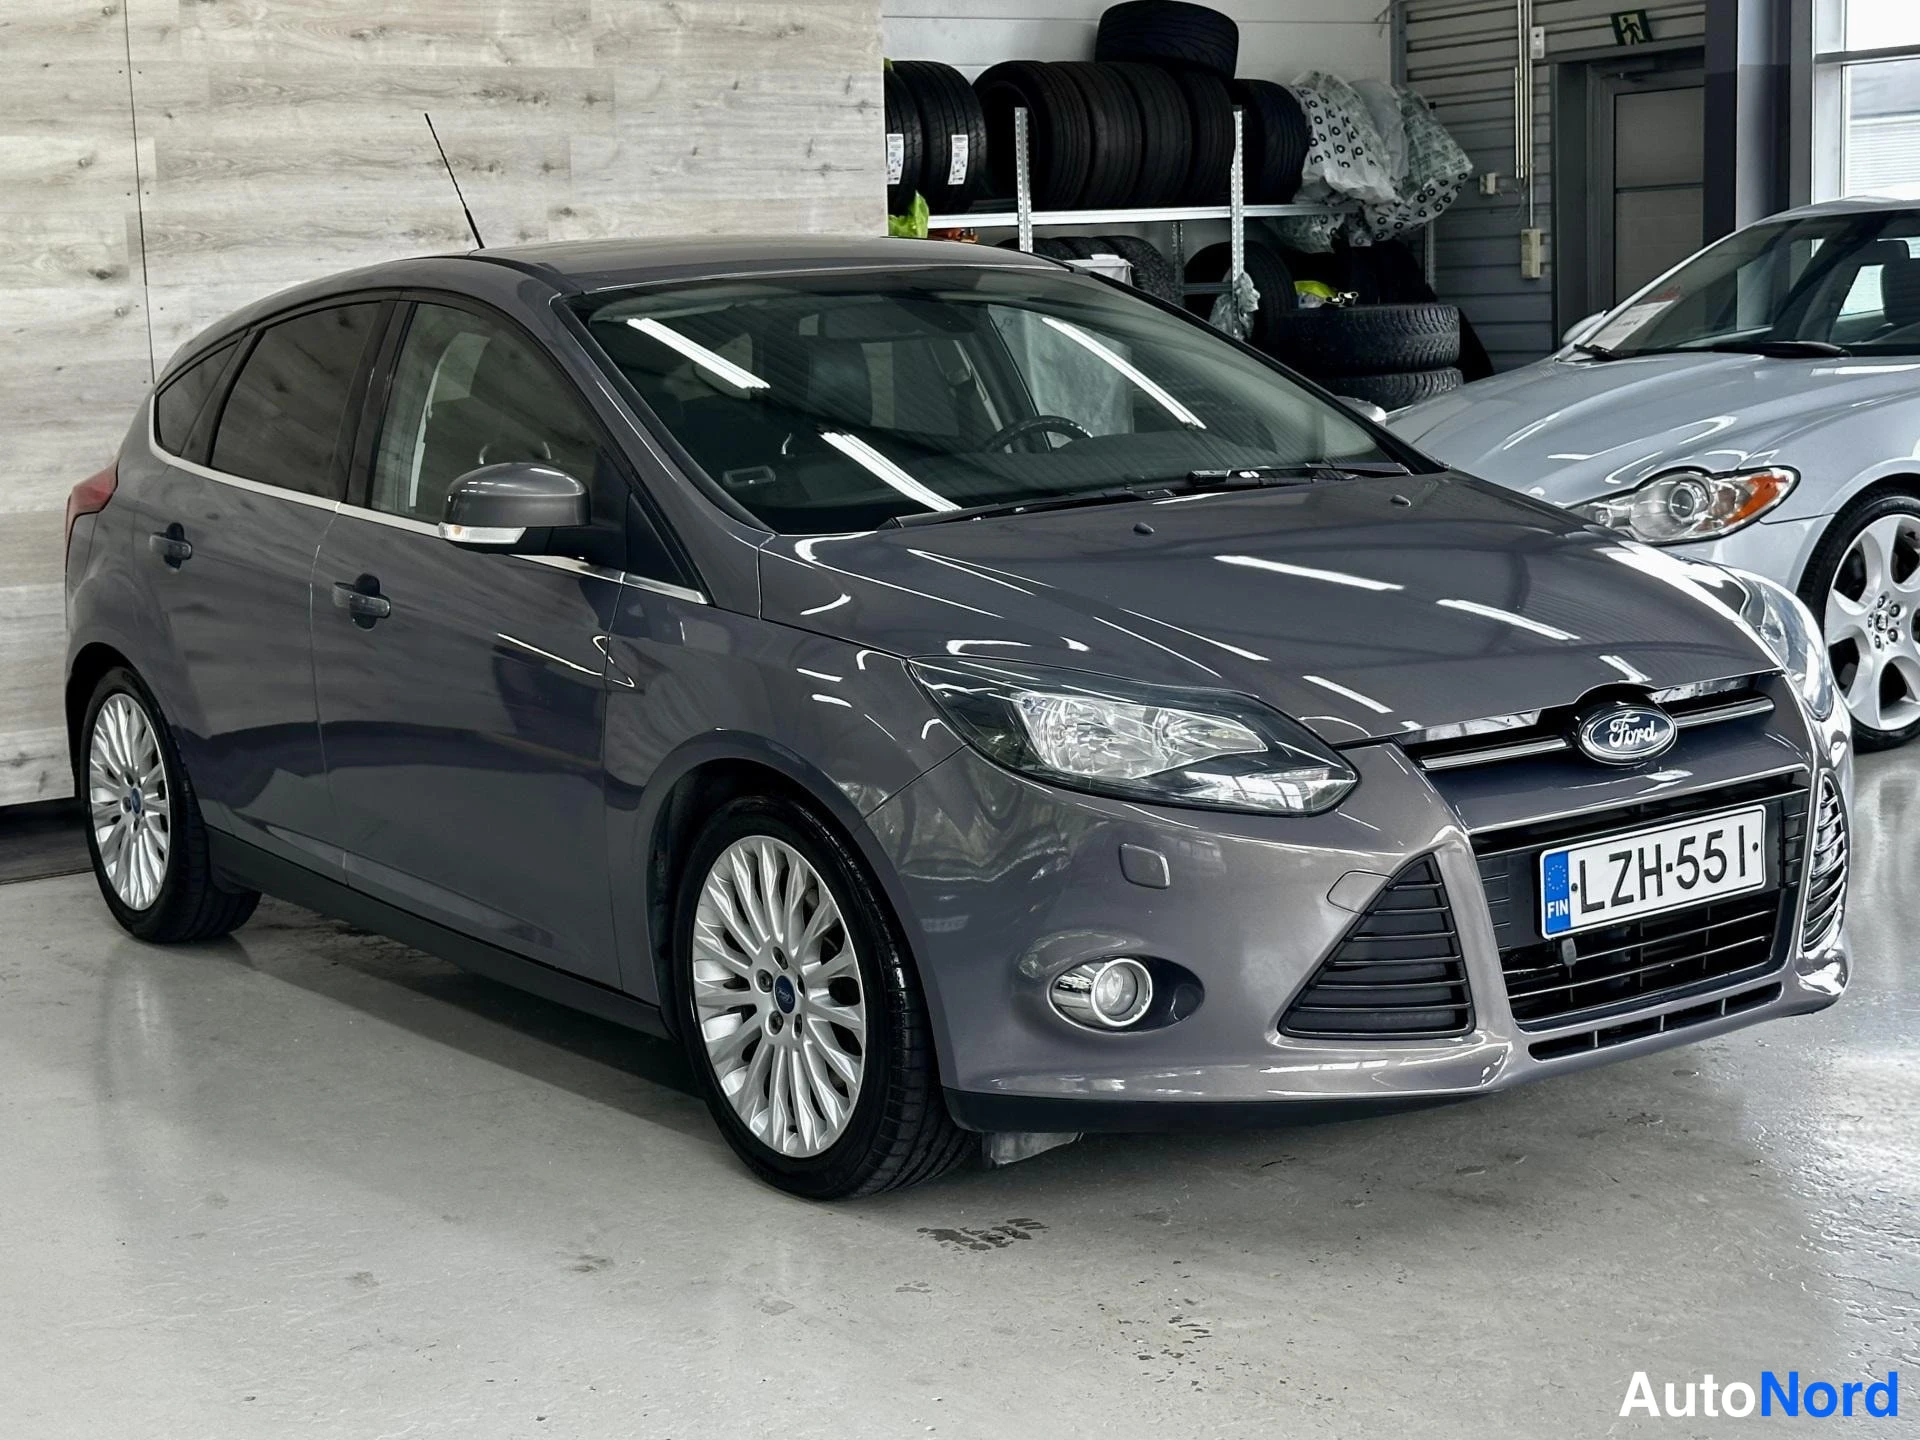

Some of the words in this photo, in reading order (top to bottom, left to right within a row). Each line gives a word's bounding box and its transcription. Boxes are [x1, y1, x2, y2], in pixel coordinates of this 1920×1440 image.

[1608, 711, 1658, 748] Ford
[1579, 825, 1746, 914] LZH-551
[1547, 899, 1568, 918] FIN
